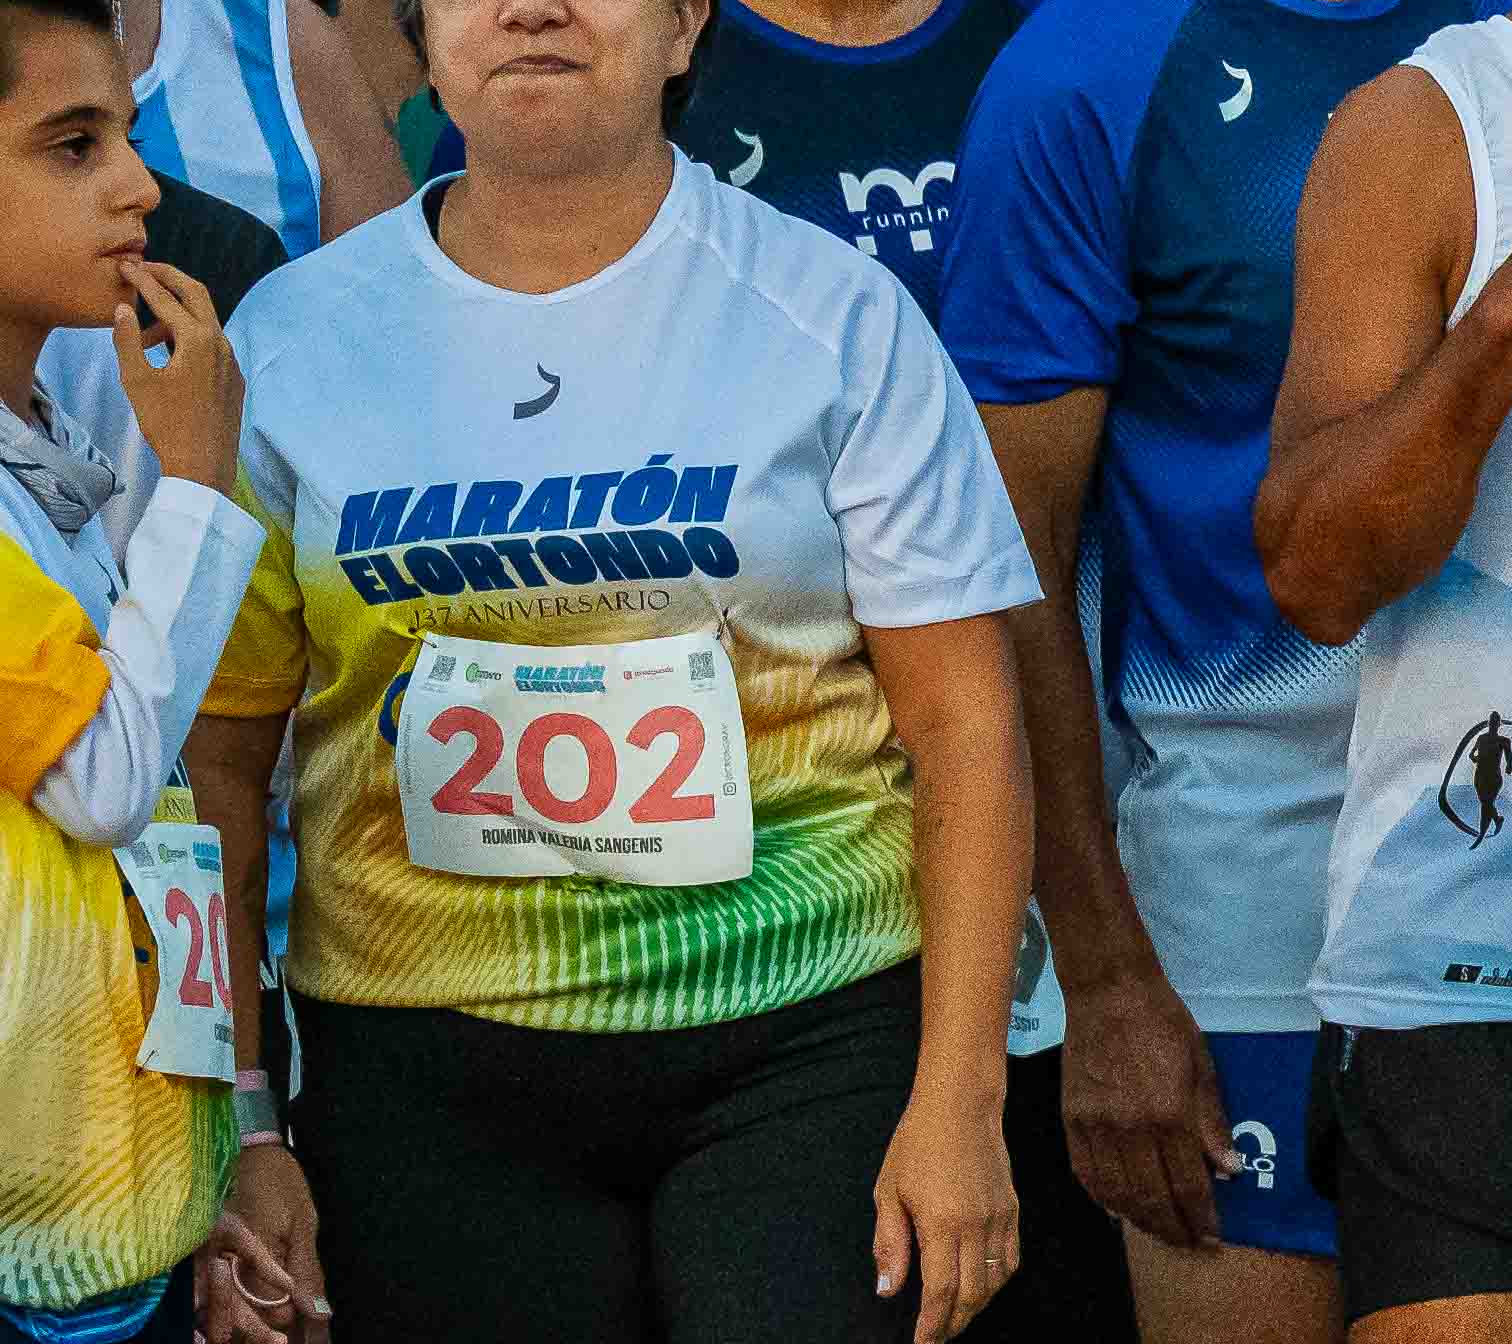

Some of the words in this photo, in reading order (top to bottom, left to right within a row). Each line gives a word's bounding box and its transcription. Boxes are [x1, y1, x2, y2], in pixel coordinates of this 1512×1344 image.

[863, 205, 951, 232] runnin
[335, 452, 740, 557] MARATÓN
[339, 527, 741, 607] ELORTONDO
[413, 606, 453, 630] 137
[463, 589, 672, 624] ANIVERSARIO
[425, 705, 716, 824] 202
[481, 828, 537, 846] ROMINA
[538, 830, 593, 853] VALERIA
[594, 836, 663, 855] SANGENIS
